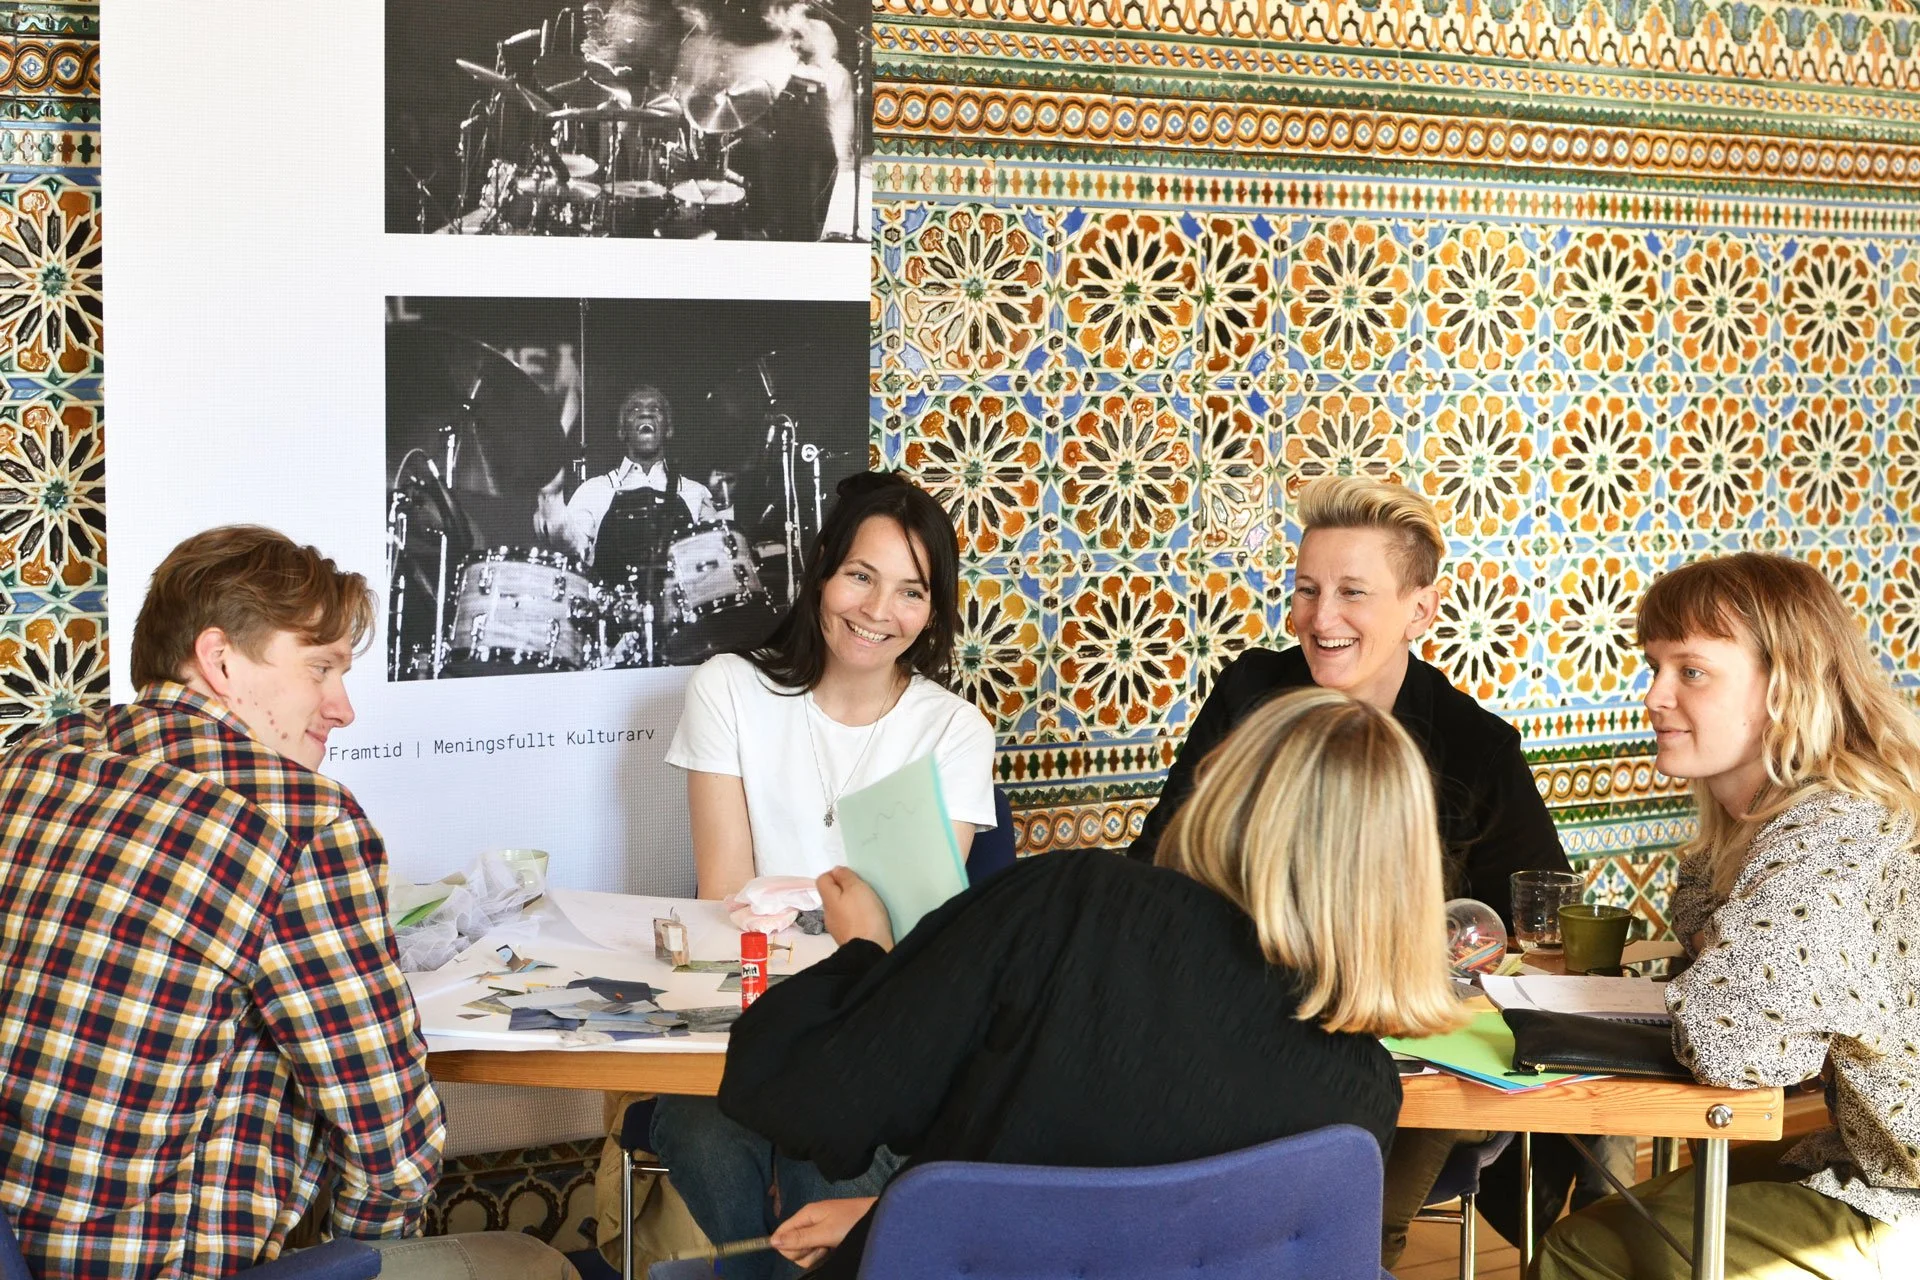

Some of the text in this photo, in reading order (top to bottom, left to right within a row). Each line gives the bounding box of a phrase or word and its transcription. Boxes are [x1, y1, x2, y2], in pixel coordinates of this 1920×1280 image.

[329, 741, 403, 762] Framtid
[434, 732, 556, 755] Meningsfullt
[567, 728, 655, 746] Kulturarv
